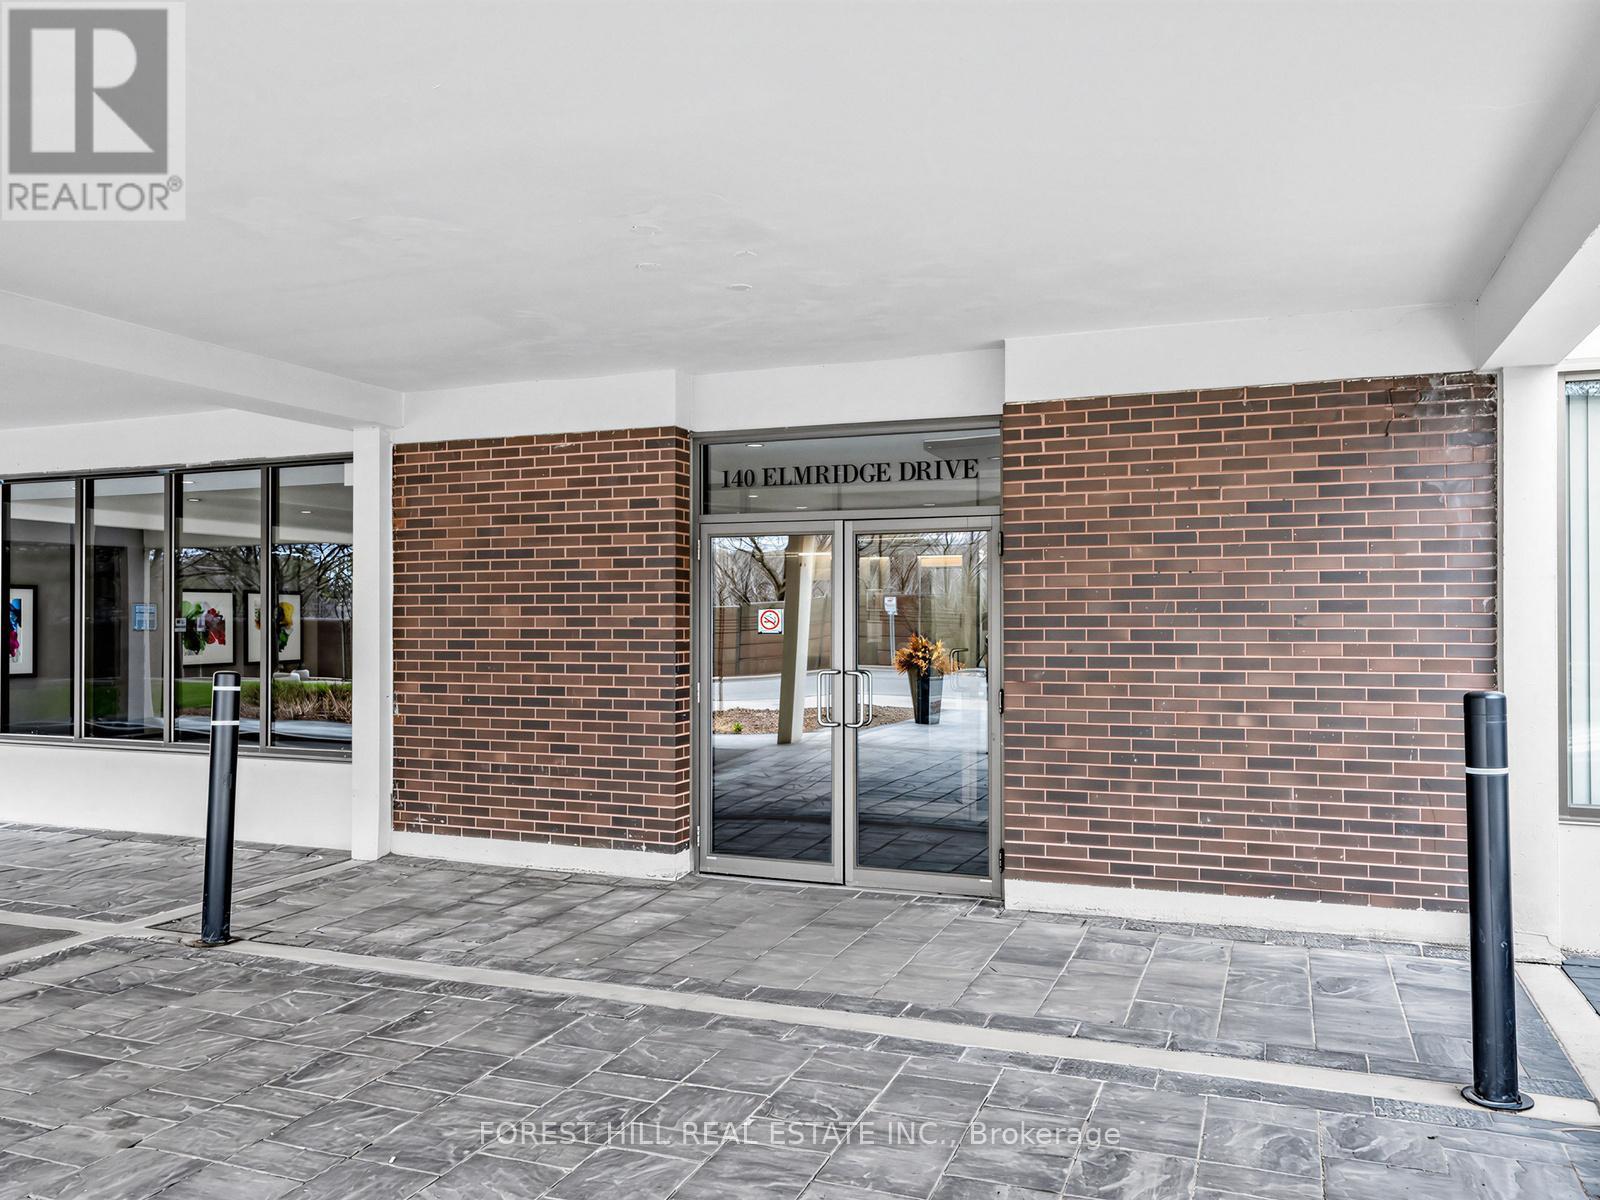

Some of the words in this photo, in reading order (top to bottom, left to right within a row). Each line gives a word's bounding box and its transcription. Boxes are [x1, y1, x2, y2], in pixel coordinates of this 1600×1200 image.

[721, 469, 755, 488] 140
[762, 462, 891, 486] ELMRIDGE
[899, 459, 979, 481] DRIVE
